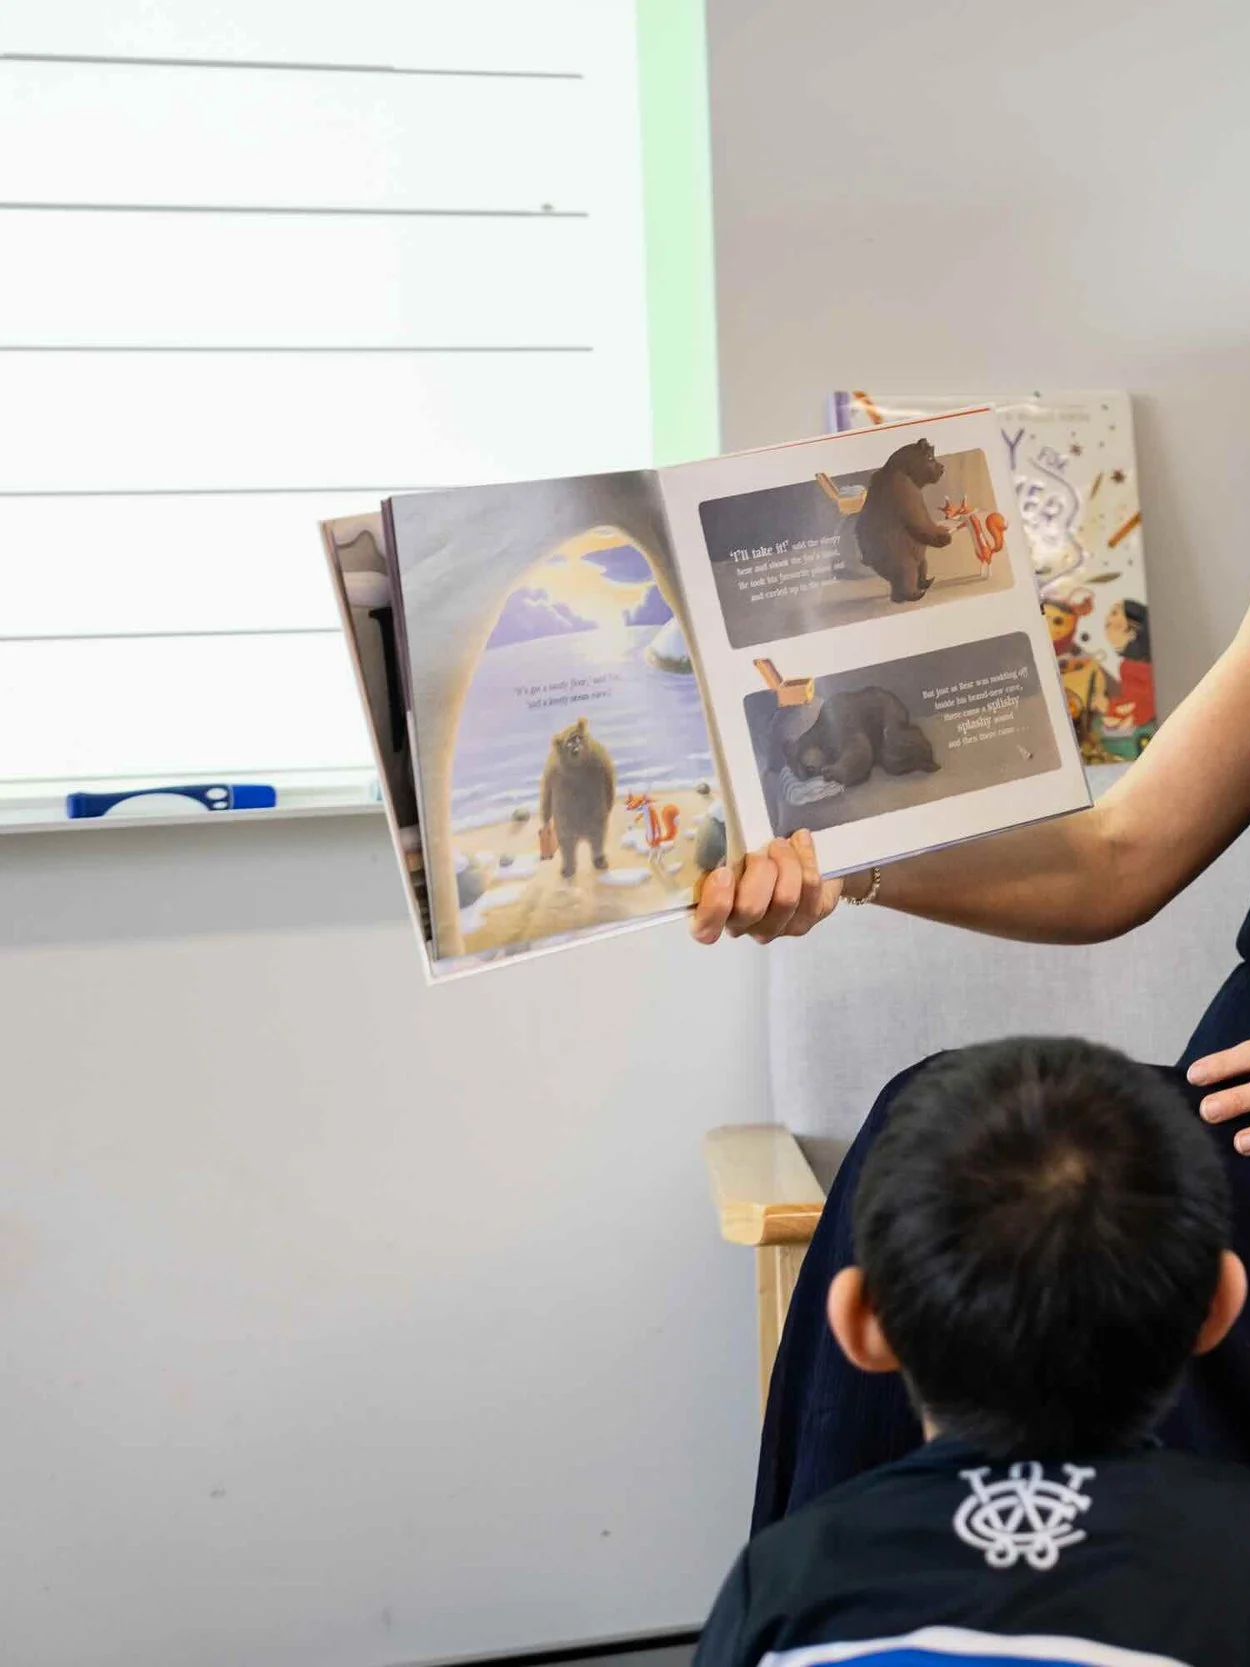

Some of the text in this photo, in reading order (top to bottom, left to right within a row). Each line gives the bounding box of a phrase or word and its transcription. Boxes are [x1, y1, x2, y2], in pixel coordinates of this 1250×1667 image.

[752, 546, 773, 559] take
[922, 690, 935, 699] But
[936, 687, 949, 698] just
[959, 682, 975, 690] Bear
[958, 717, 991, 734] splashy
